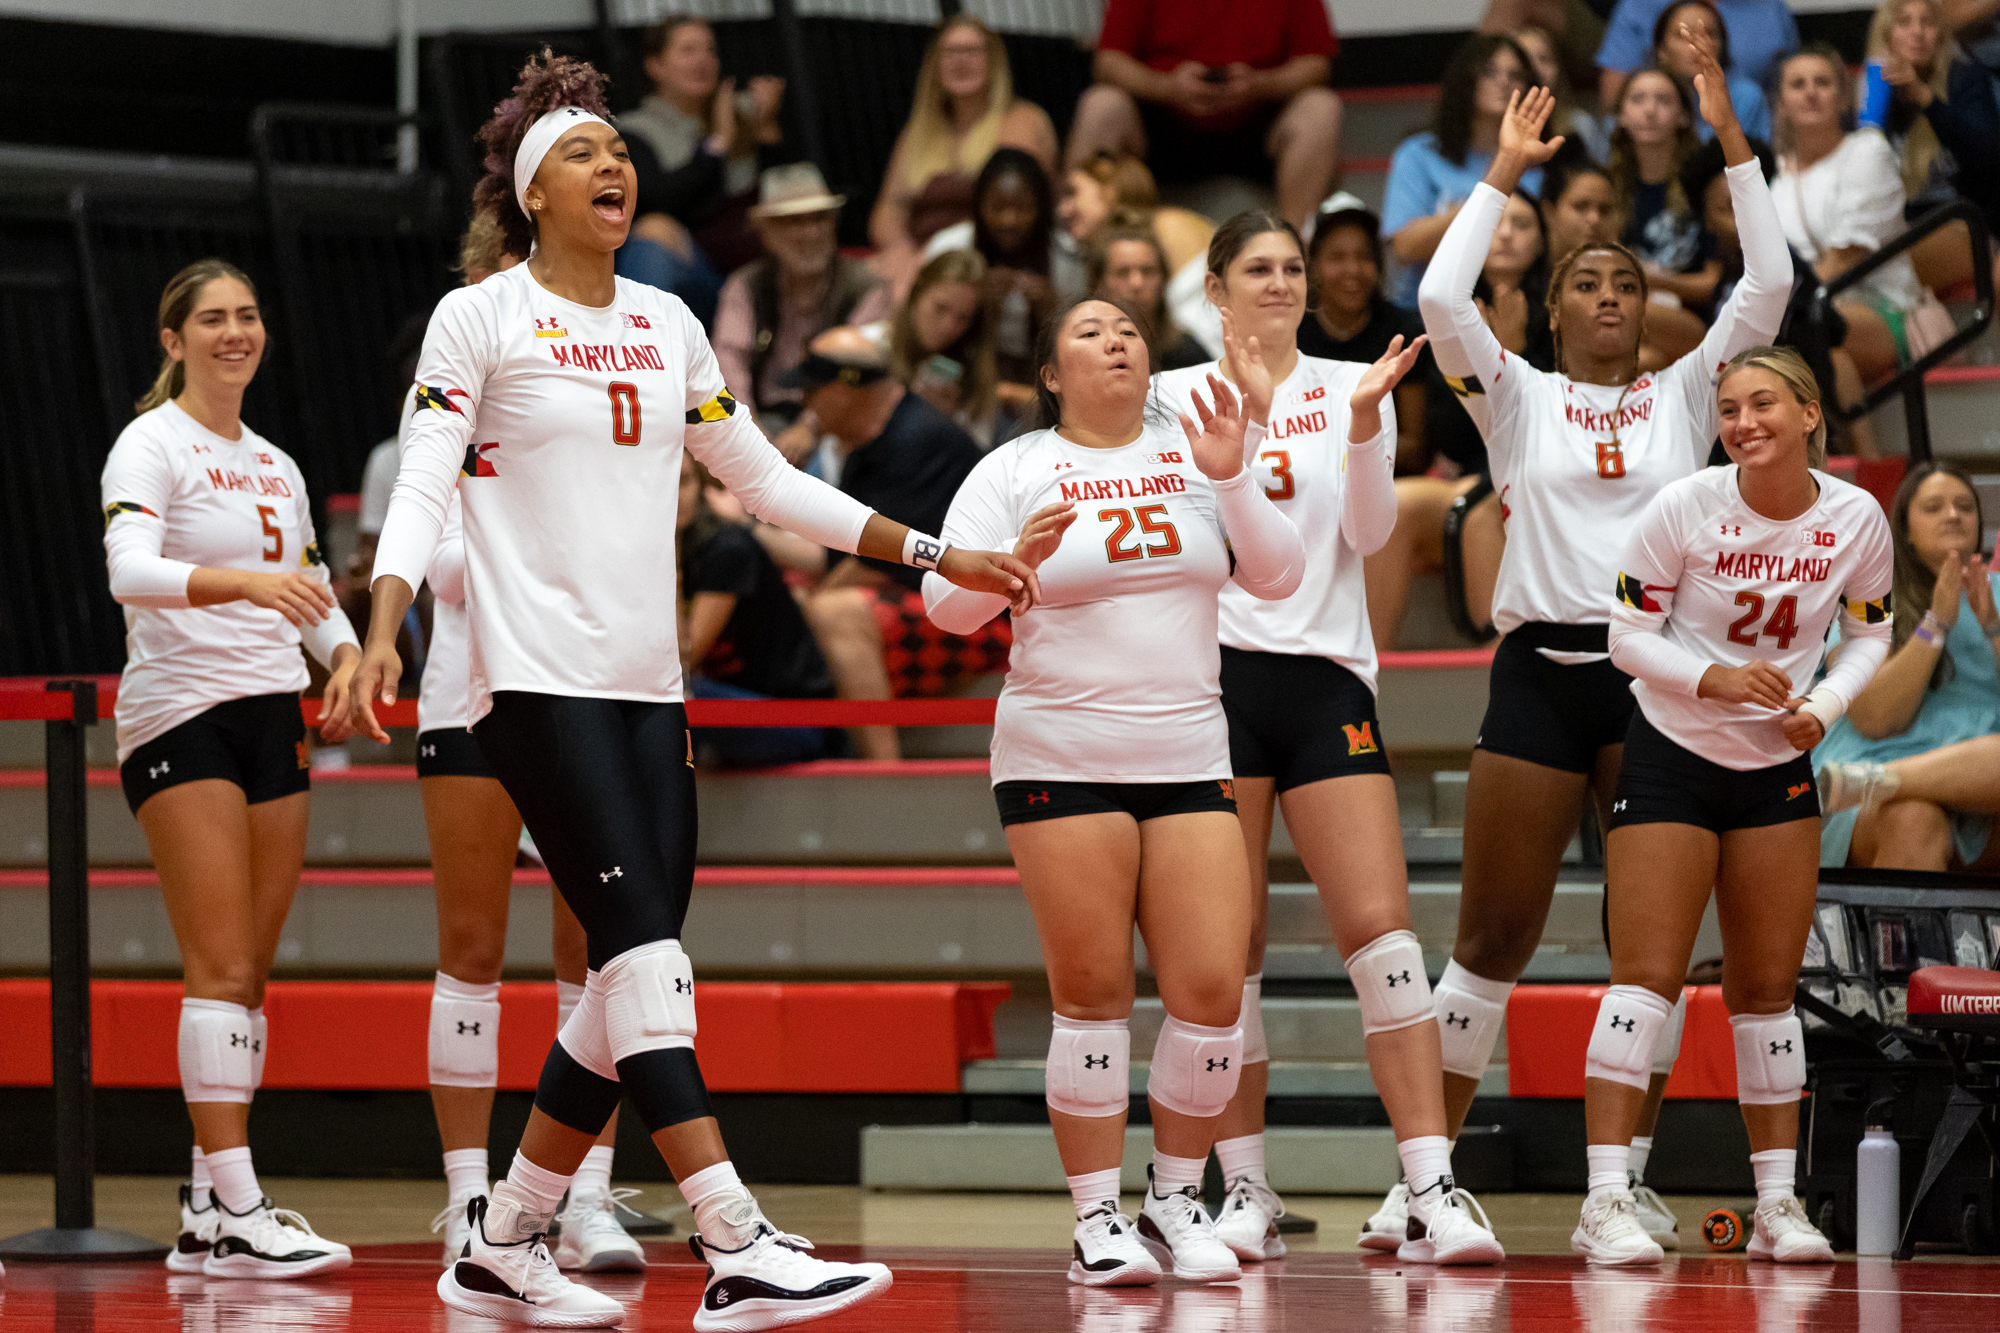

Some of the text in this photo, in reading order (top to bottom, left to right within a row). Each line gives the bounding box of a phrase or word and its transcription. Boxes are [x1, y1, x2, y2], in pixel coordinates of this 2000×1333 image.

[549, 343, 665, 372] MARYLAND
[607, 380, 642, 446] 0
[1264, 410, 1328, 441] LAND
[1260, 450, 1296, 501] 3
[1595, 441, 1627, 479] 6
[1059, 473, 1186, 502] MARYLAND
[256, 504, 283, 562] 5
[1097, 503, 1182, 563] 25
[1714, 551, 1832, 582] MARYLAND
[1727, 591, 1799, 649] 24
